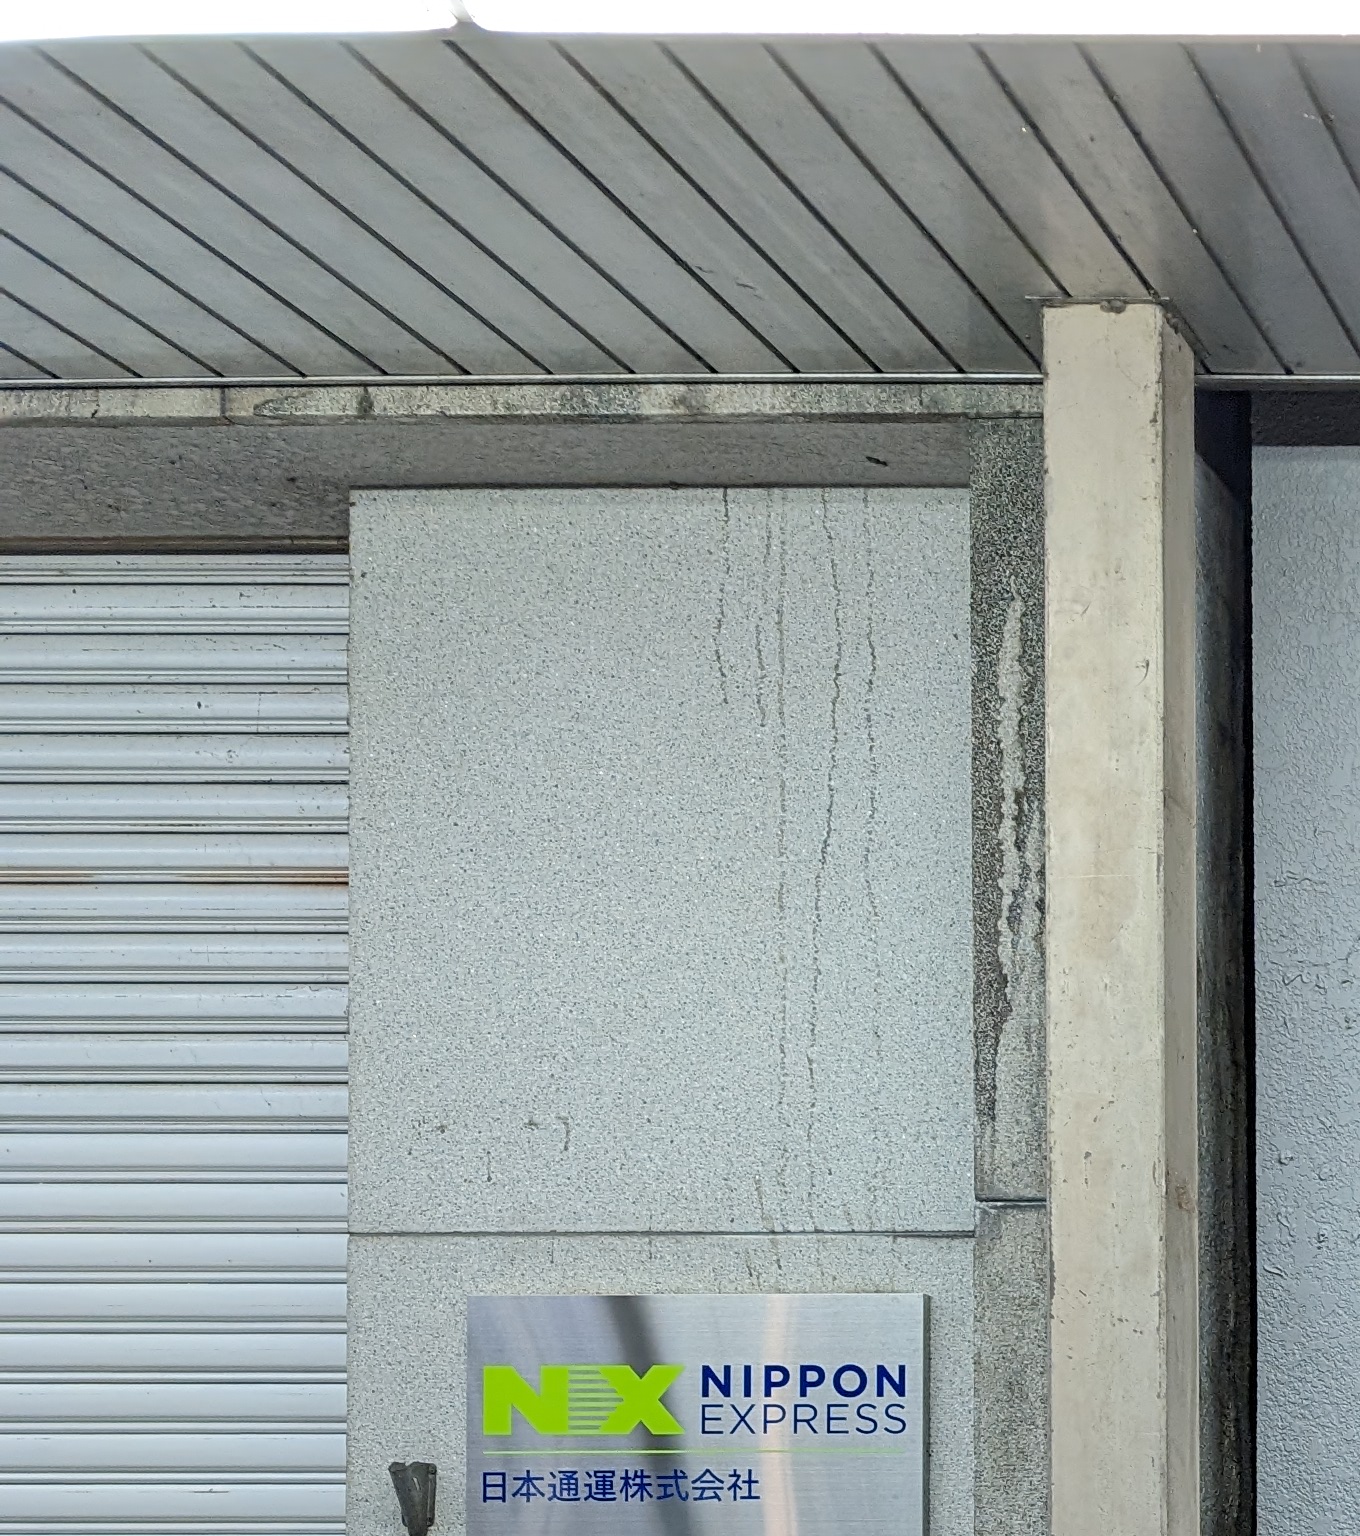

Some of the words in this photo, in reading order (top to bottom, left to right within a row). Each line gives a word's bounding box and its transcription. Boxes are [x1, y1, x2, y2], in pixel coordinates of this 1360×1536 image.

[701, 1364, 907, 1399] NIPPON
[483, 1364, 686, 1436] NX
[701, 1403, 907, 1436] EXPRESS
[481, 1468, 761, 1502] 日本通運株式会社
